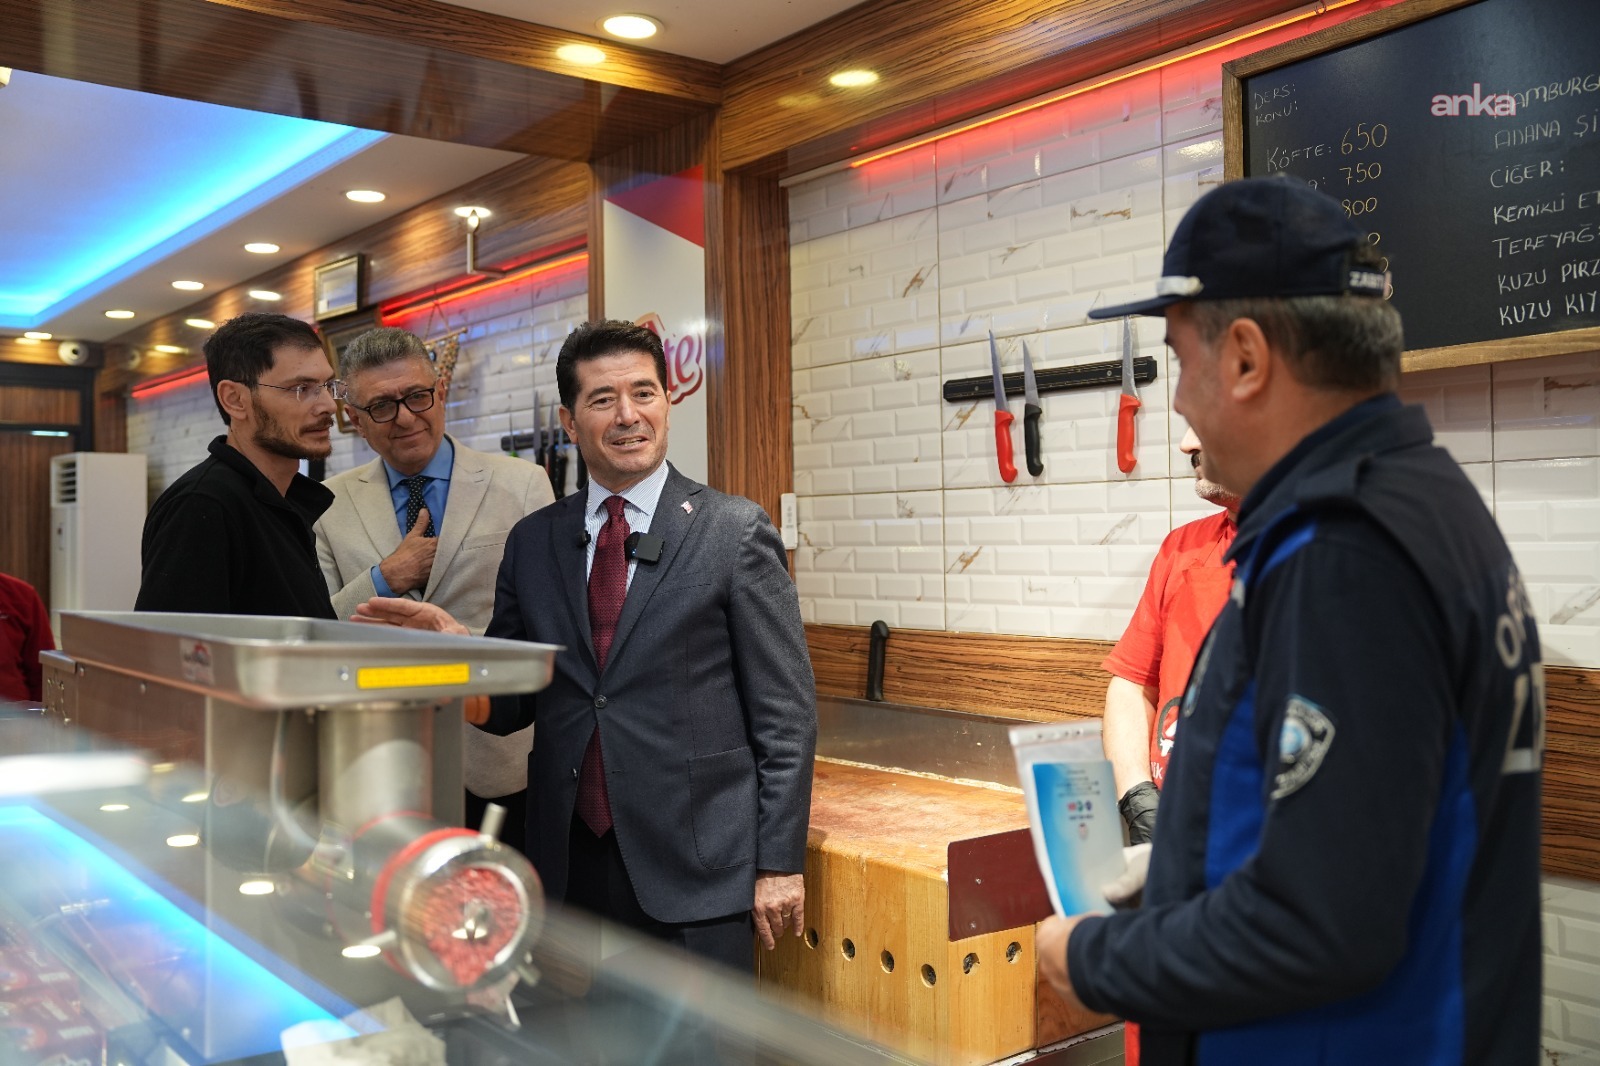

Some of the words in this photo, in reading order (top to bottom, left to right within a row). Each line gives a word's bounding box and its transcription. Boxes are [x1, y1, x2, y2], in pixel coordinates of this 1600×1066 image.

[1254, 83, 1296, 111] DERS:
[1266, 143, 1332, 173] KÖFTE:
[1341, 122, 1388, 155] 650
[1494, 119, 1561, 149] ADANA
[1339, 162, 1382, 185] 750
[1341, 197, 1378, 219] 800
[1497, 268, 1547, 295] KUZU
[1499, 299, 1551, 326] KUZU
[1565, 290, 1597, 315] KIY
